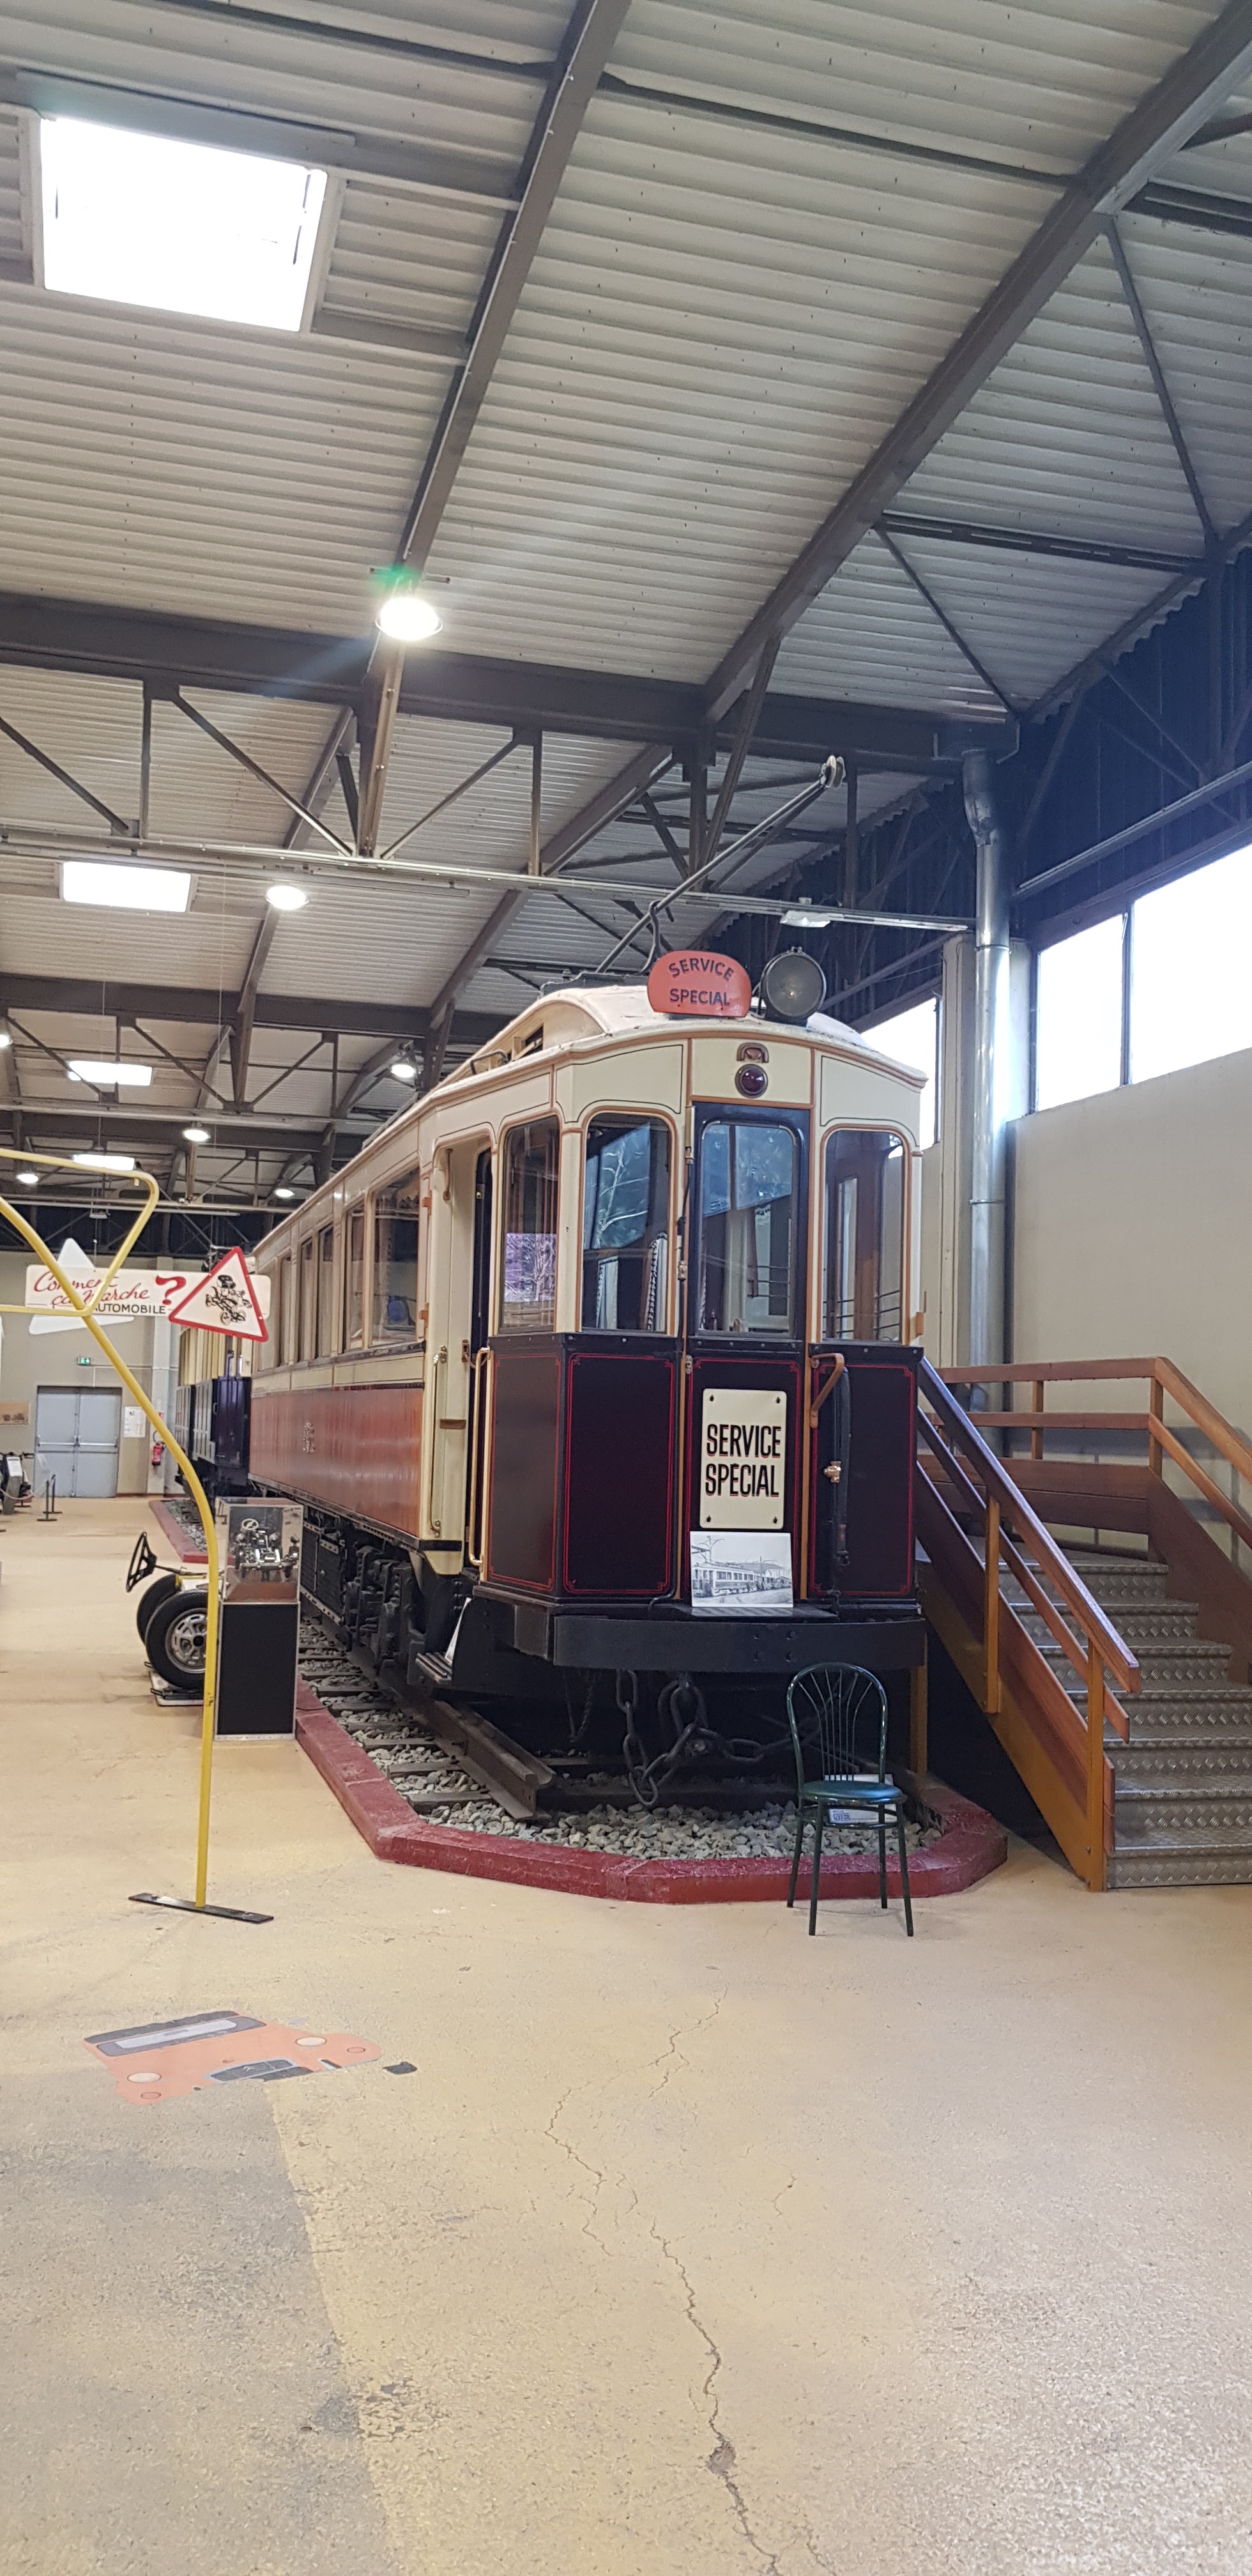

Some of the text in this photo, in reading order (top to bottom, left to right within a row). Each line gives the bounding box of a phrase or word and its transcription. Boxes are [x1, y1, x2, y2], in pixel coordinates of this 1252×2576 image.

[669, 958, 734, 981] SERVICE
[155, 1275, 187, 1305] ?
[96, 1303, 166, 1314] UTOMOBILE
[706, 1423, 781, 1458] SERVICE
